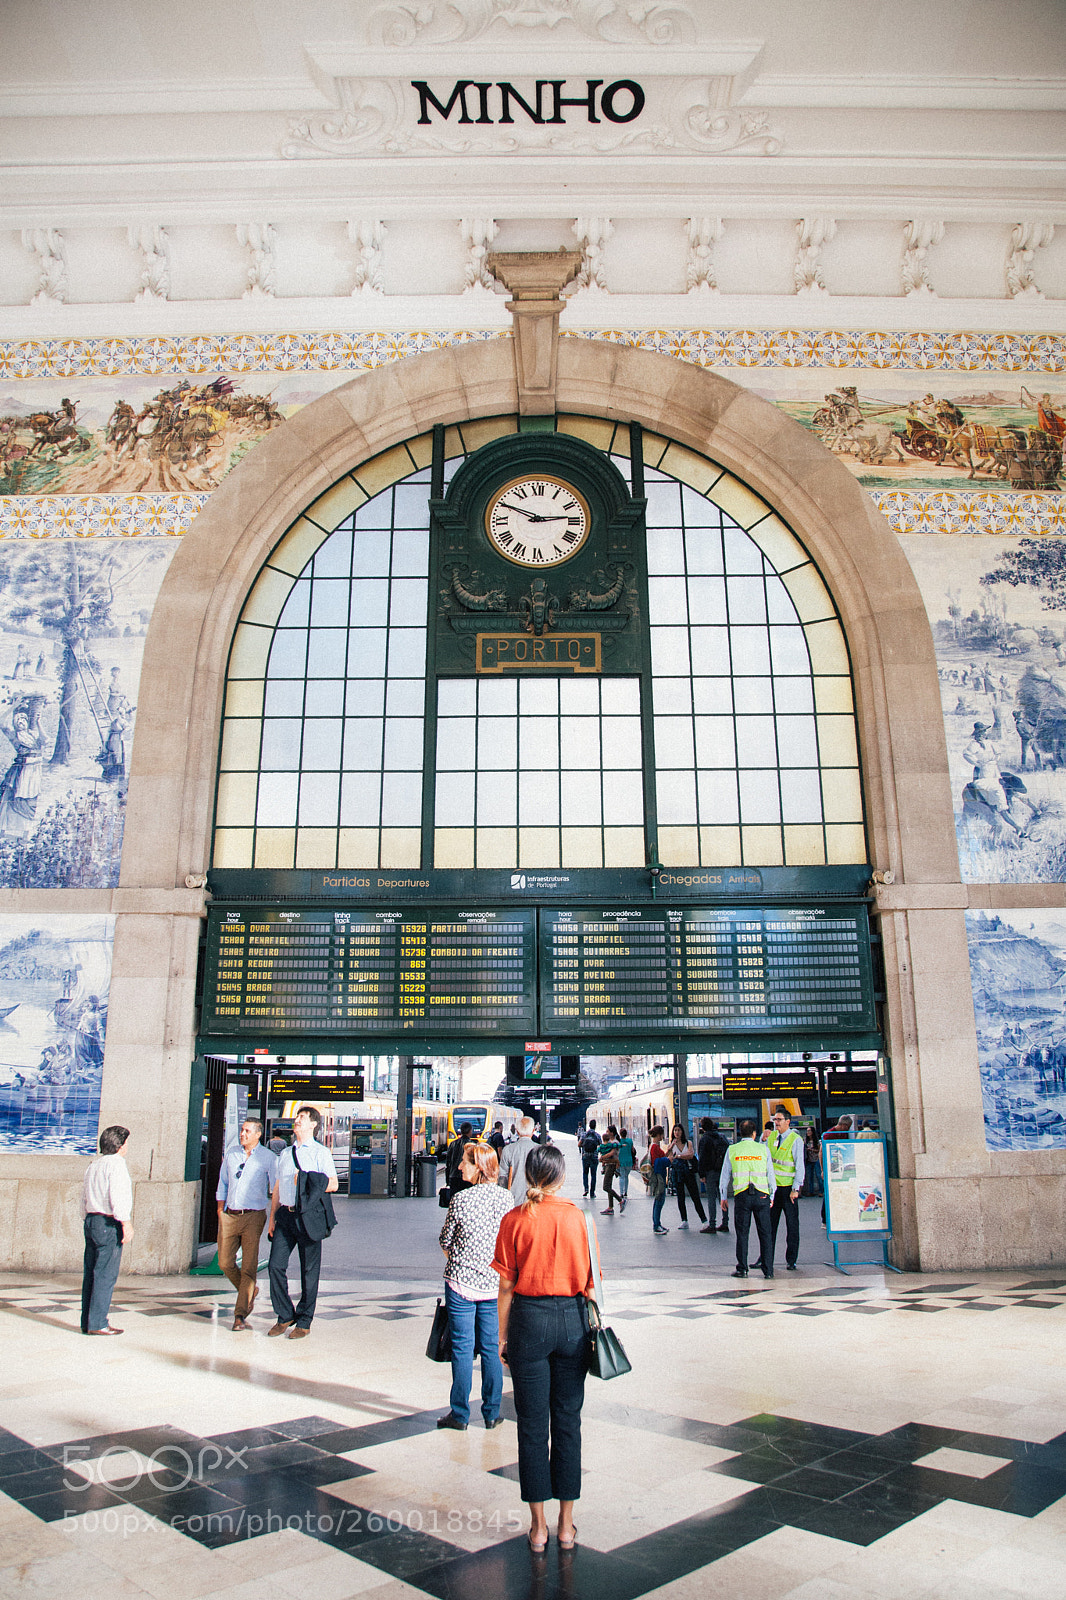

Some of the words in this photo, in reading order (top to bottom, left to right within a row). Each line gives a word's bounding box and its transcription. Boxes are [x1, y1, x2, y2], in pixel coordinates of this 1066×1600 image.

[411, 80, 645, 124] MINHO
[532, 486, 544, 496] XII
[563, 501, 575, 510] II
[568, 517, 580, 525] III
[497, 640, 581, 660] PORTO
[323, 876, 370, 887] Partidas
[377, 878, 430, 888] Departures
[660, 874, 722, 886] Chegadas
[340, 925, 346, 933] 3
[350, 925, 381, 933] SUBURB
[583, 924, 619, 932] POCINHO
[685, 923, 696, 931] IR
[249, 936, 290, 944] PENAFIEL
[685, 935, 716, 943] SUBURB
[248, 948, 279, 956] AVEIRO
[339, 948, 345, 956] 6
[349, 948, 380, 956] SUBURB
[400, 948, 426, 956] 15736
[430, 948, 467, 956] COMBOIO
[472, 948, 482, 956] DA
[487, 948, 518, 956] FRENTE
[248, 960, 273, 968] REGUA
[339, 960, 344, 968] 1
[350, 960, 359, 968] IR
[410, 960, 426, 968] 869
[686, 958, 717, 966] SUBURB
[338, 972, 344, 980] 4
[348, 972, 379, 980] SUBURB
[400, 972, 426, 980] 15533
[686, 970, 718, 978] SUBURB
[338, 984, 342, 992] 1
[348, 984, 379, 992] SUBURB
[400, 984, 426, 992] 15229
[687, 982, 718, 990] SUBURB
[337, 996, 343, 1004] 5
[348, 996, 379, 1004] SUBURB
[430, 996, 467, 1004] COMBOIO
[472, 996, 482, 1004] DA
[584, 995, 611, 1003] BRAGA
[688, 994, 719, 1002] SUBURB
[739, 994, 765, 1002] 15232
[337, 1008, 342, 1016] 4
[347, 1008, 378, 1016] SUBURB
[399, 1008, 425, 1016] 15415
[688, 1006, 719, 1014] SUBURB
